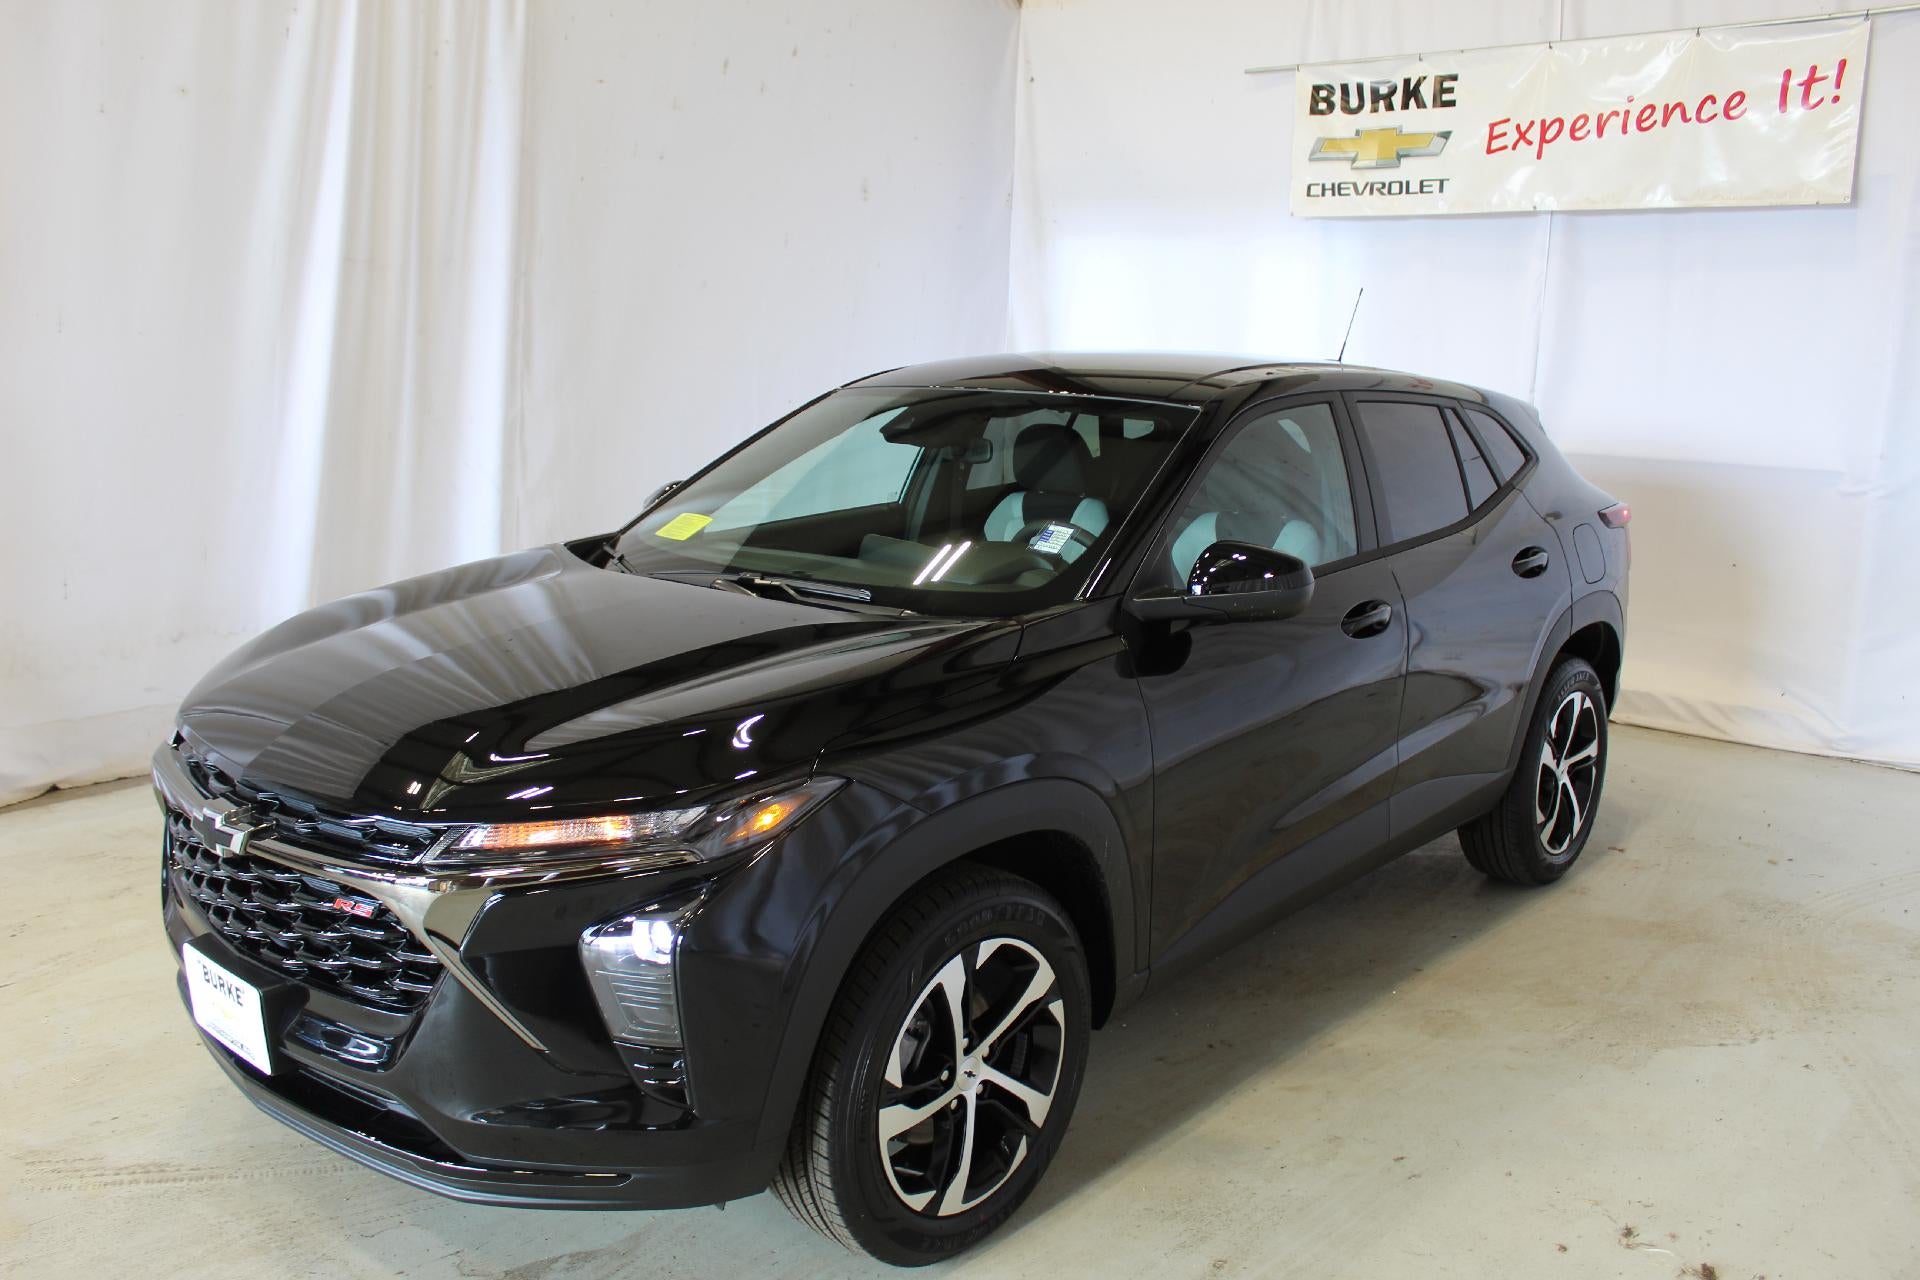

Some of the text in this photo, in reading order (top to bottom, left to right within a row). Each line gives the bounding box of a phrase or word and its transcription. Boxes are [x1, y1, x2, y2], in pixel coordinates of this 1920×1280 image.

[1309, 73, 1459, 116] BURKE
[1485, 58, 1848, 160] Experience It!
[1306, 177, 1450, 198] CHEVROLET
[333, 898, 375, 918] RS
[202, 964, 244, 1007] BURKE
